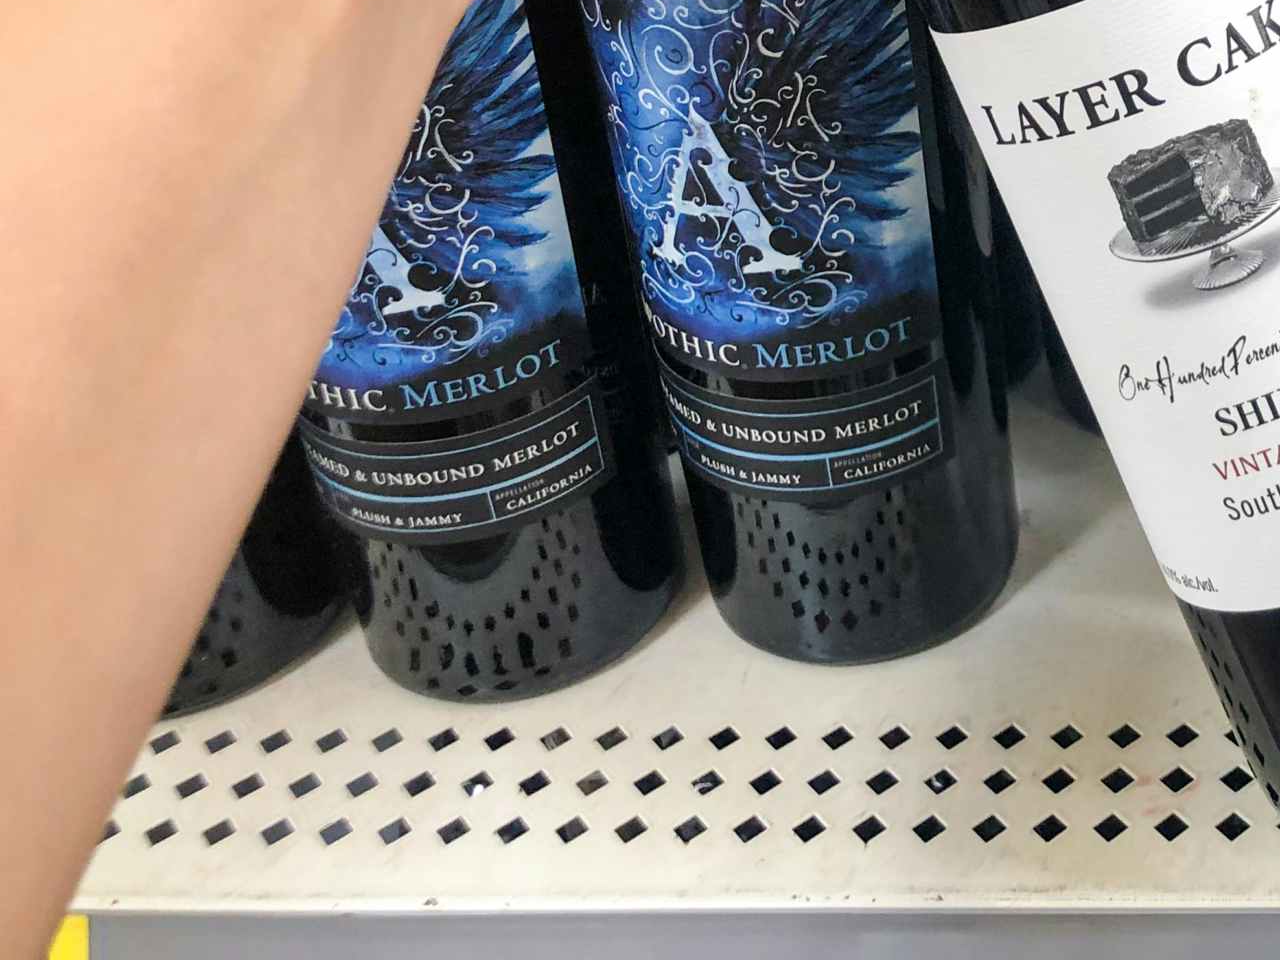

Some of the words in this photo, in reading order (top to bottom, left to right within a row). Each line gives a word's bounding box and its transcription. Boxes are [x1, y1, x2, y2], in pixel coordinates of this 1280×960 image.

[981, 68, 1166, 146] LAYER
[651, 310, 741, 368] OTHIC
[755, 316, 912, 369] MERLOT
[309, 379, 387, 412] THIC
[399, 339, 562, 411] MERLOT
[1119, 363, 1152, 401] One
[1150, 355, 1230, 404] Hundred
[705, 418, 718, 433] &
[720, 424, 827, 445] UNBOUND
[835, 399, 923, 440] MERLOT
[354, 469, 368, 483] &
[371, 462, 486, 487] UNBOUND
[492, 420, 581, 473] MERLOT
[701, 452, 737, 478] PLUSH
[739, 469, 749, 480] &
[751, 471, 802, 485] JAMMY
[843, 442, 931, 481] CALIFORNIA
[505, 463, 594, 511] CALIFORNIA
[350, 506, 392, 527] PLUSH
[395, 517, 405, 526] &
[408, 511, 464, 528] JAMMY
